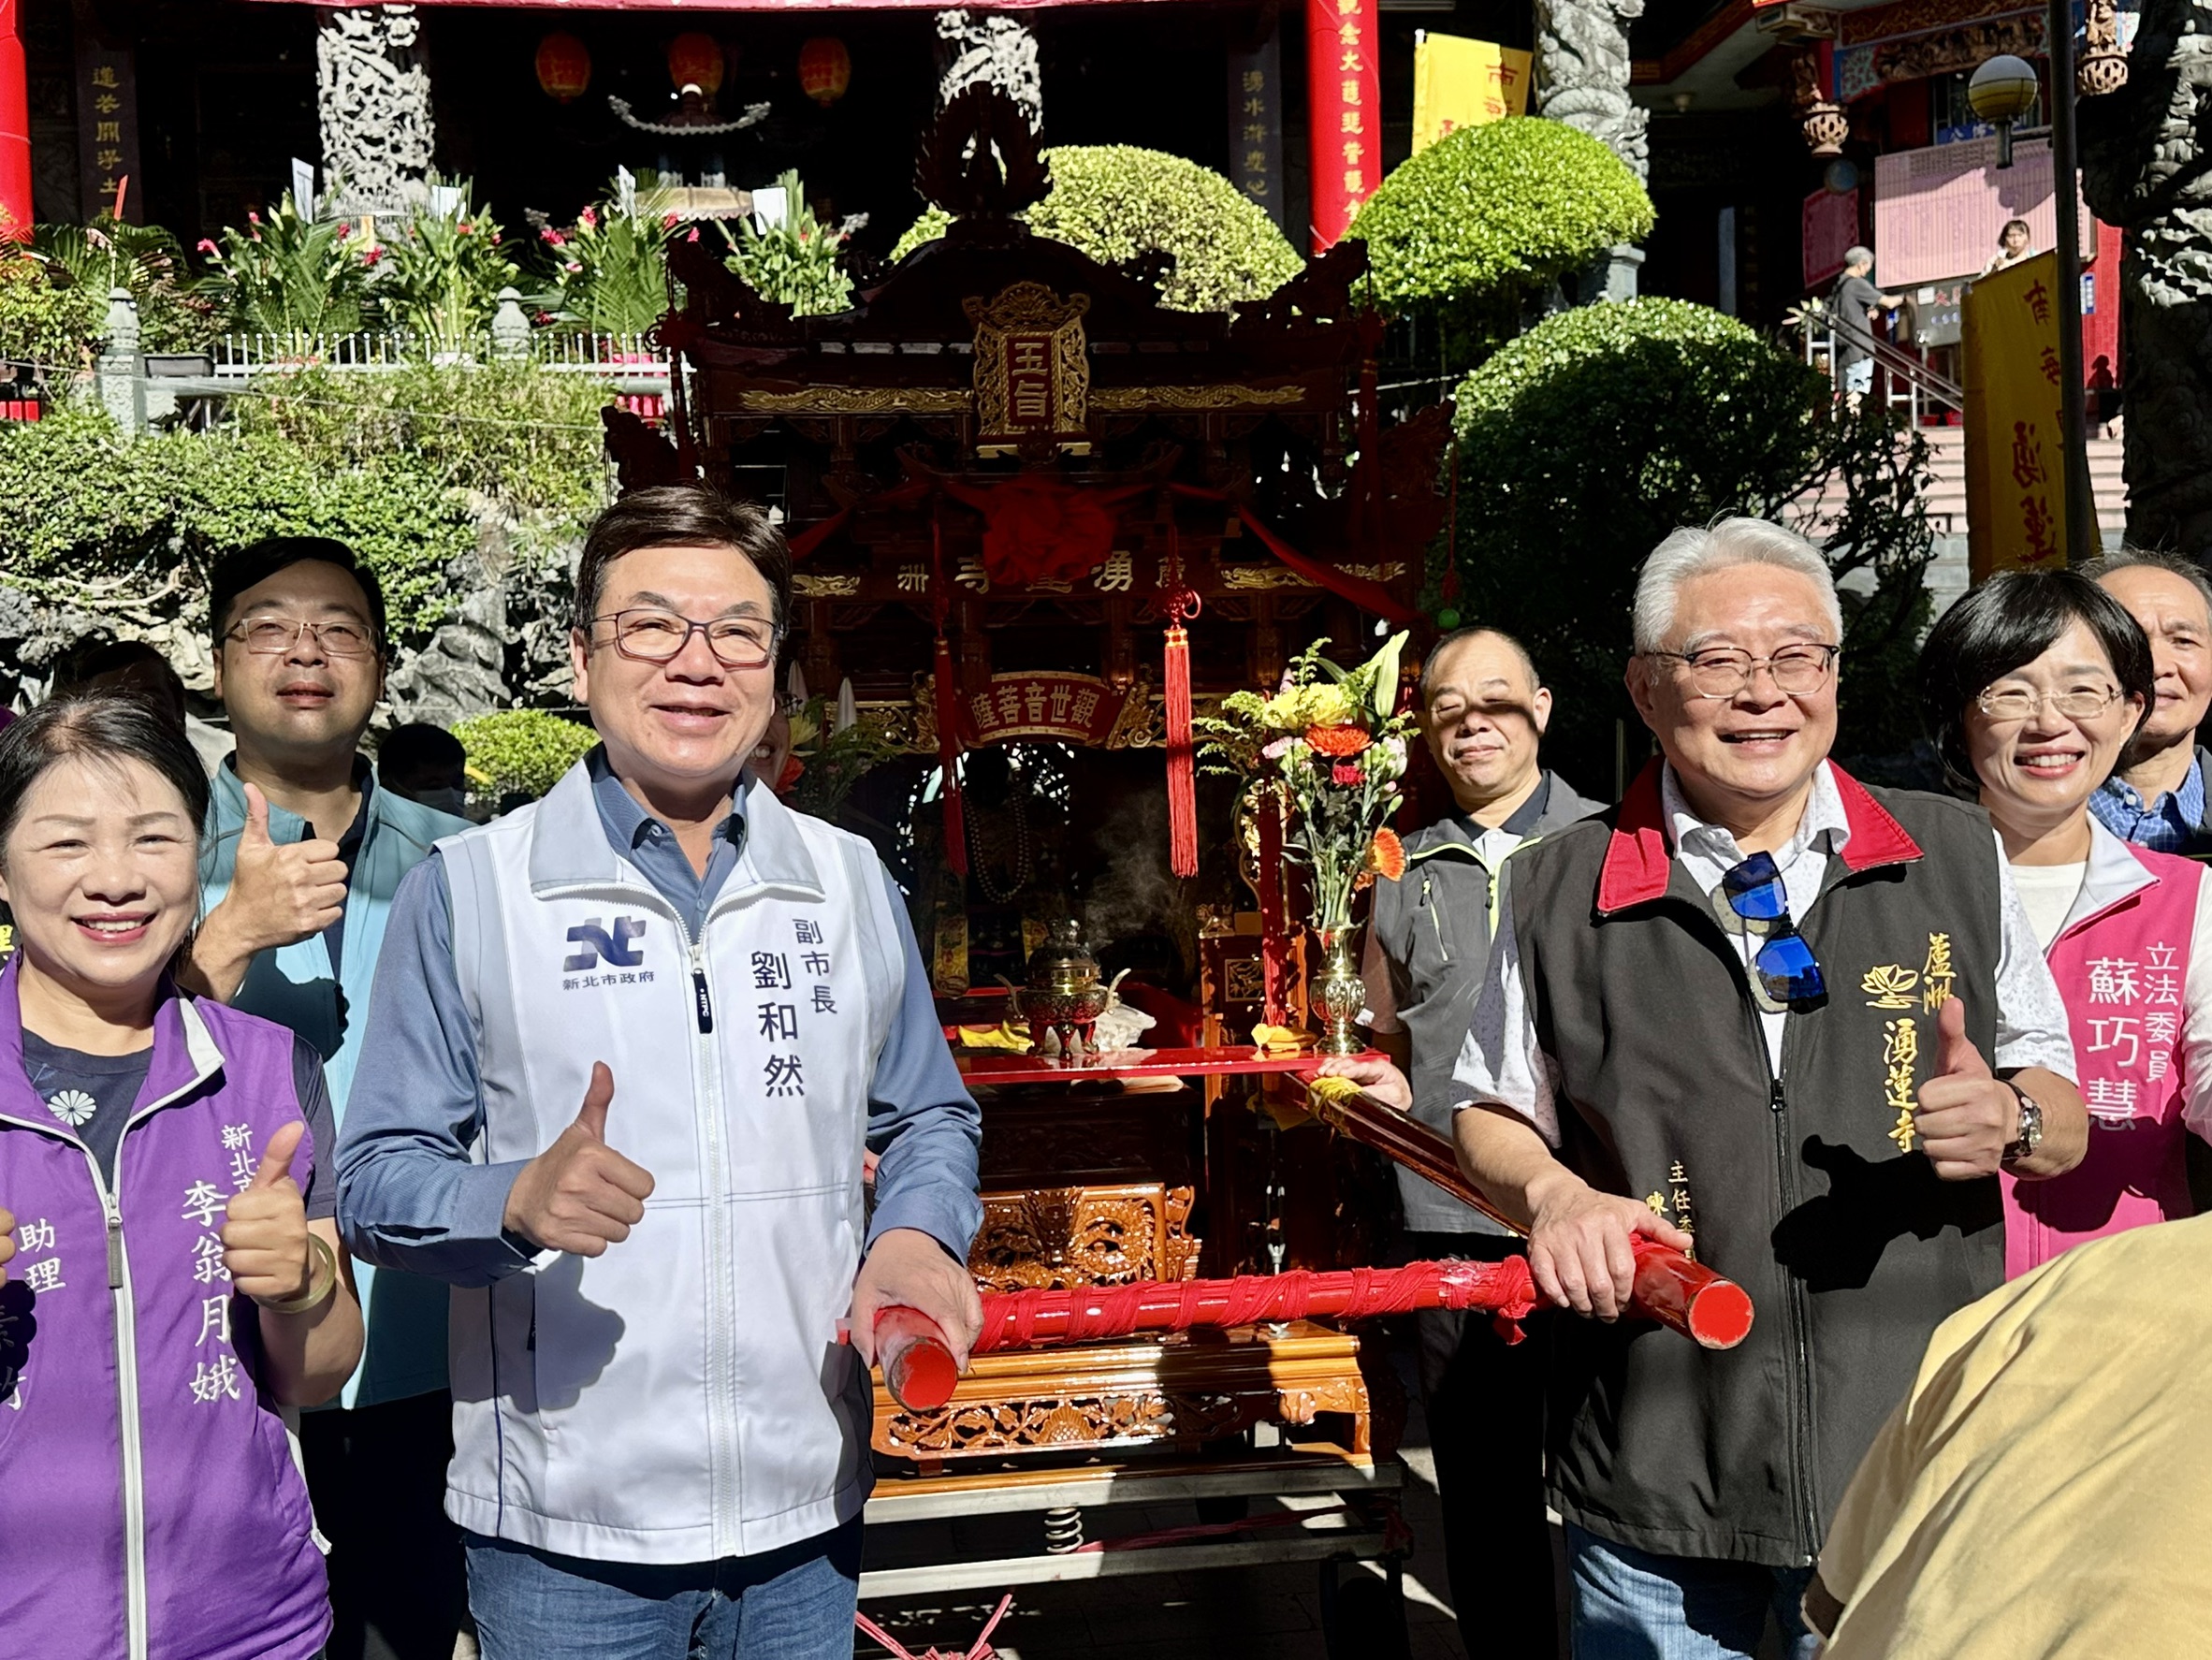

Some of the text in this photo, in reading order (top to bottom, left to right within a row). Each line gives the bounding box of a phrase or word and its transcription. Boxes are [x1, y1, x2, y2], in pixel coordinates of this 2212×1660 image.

[1011, 342, 1049, 417] 玉旨
[969, 680, 1100, 730] 觀世音菩薩
[562, 970, 655, 991] 新北市政府
[701, 993, 710, 1017] NTPC
[792, 918, 838, 1015] 副市長
[2144, 940, 2180, 1083] 立法委員
[750, 950, 805, 1098] 劉和然
[2085, 956, 2140, 1132] 蘇巧慧
[1883, 1017, 1919, 1154] 湧蓮寺
[19, 1217, 67, 1294] 助理
[182, 1179, 240, 1405] 李翁月娥
